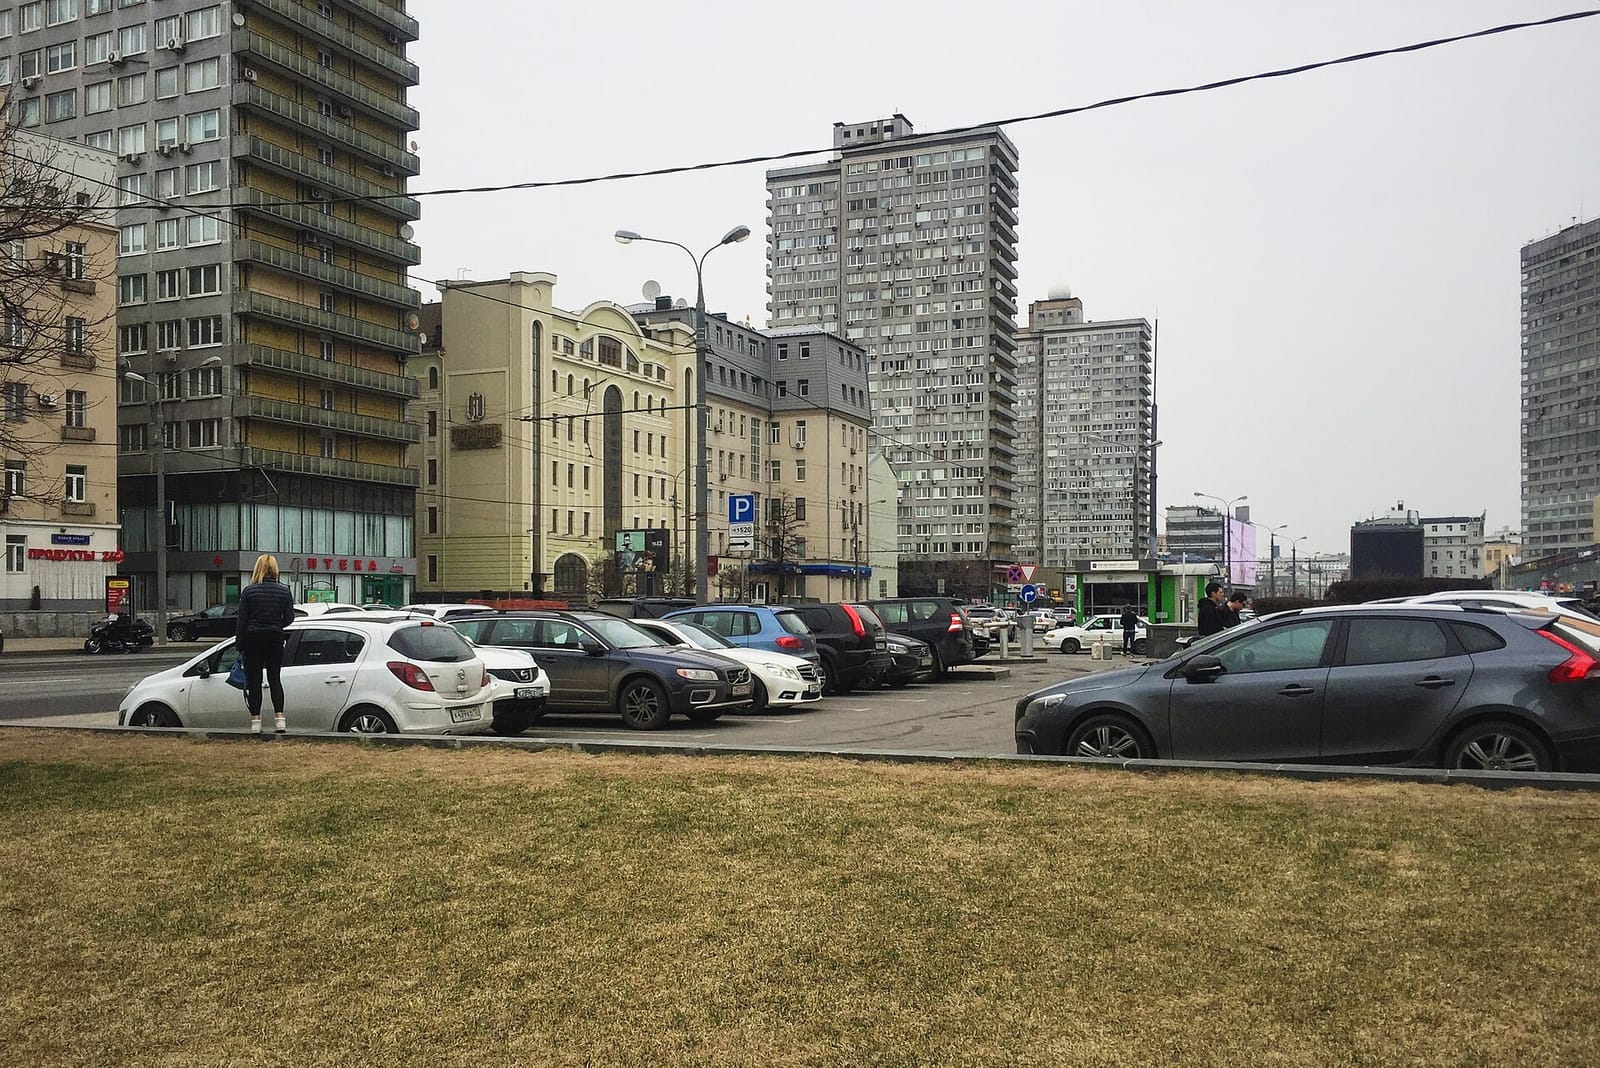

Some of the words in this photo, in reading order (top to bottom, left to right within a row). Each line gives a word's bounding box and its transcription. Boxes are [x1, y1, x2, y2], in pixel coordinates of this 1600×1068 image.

[735, 498, 750, 520] P
[28, 548, 95, 561] ПРОДУКТЫ
[306, 558, 377, 571] ПТЕКА
